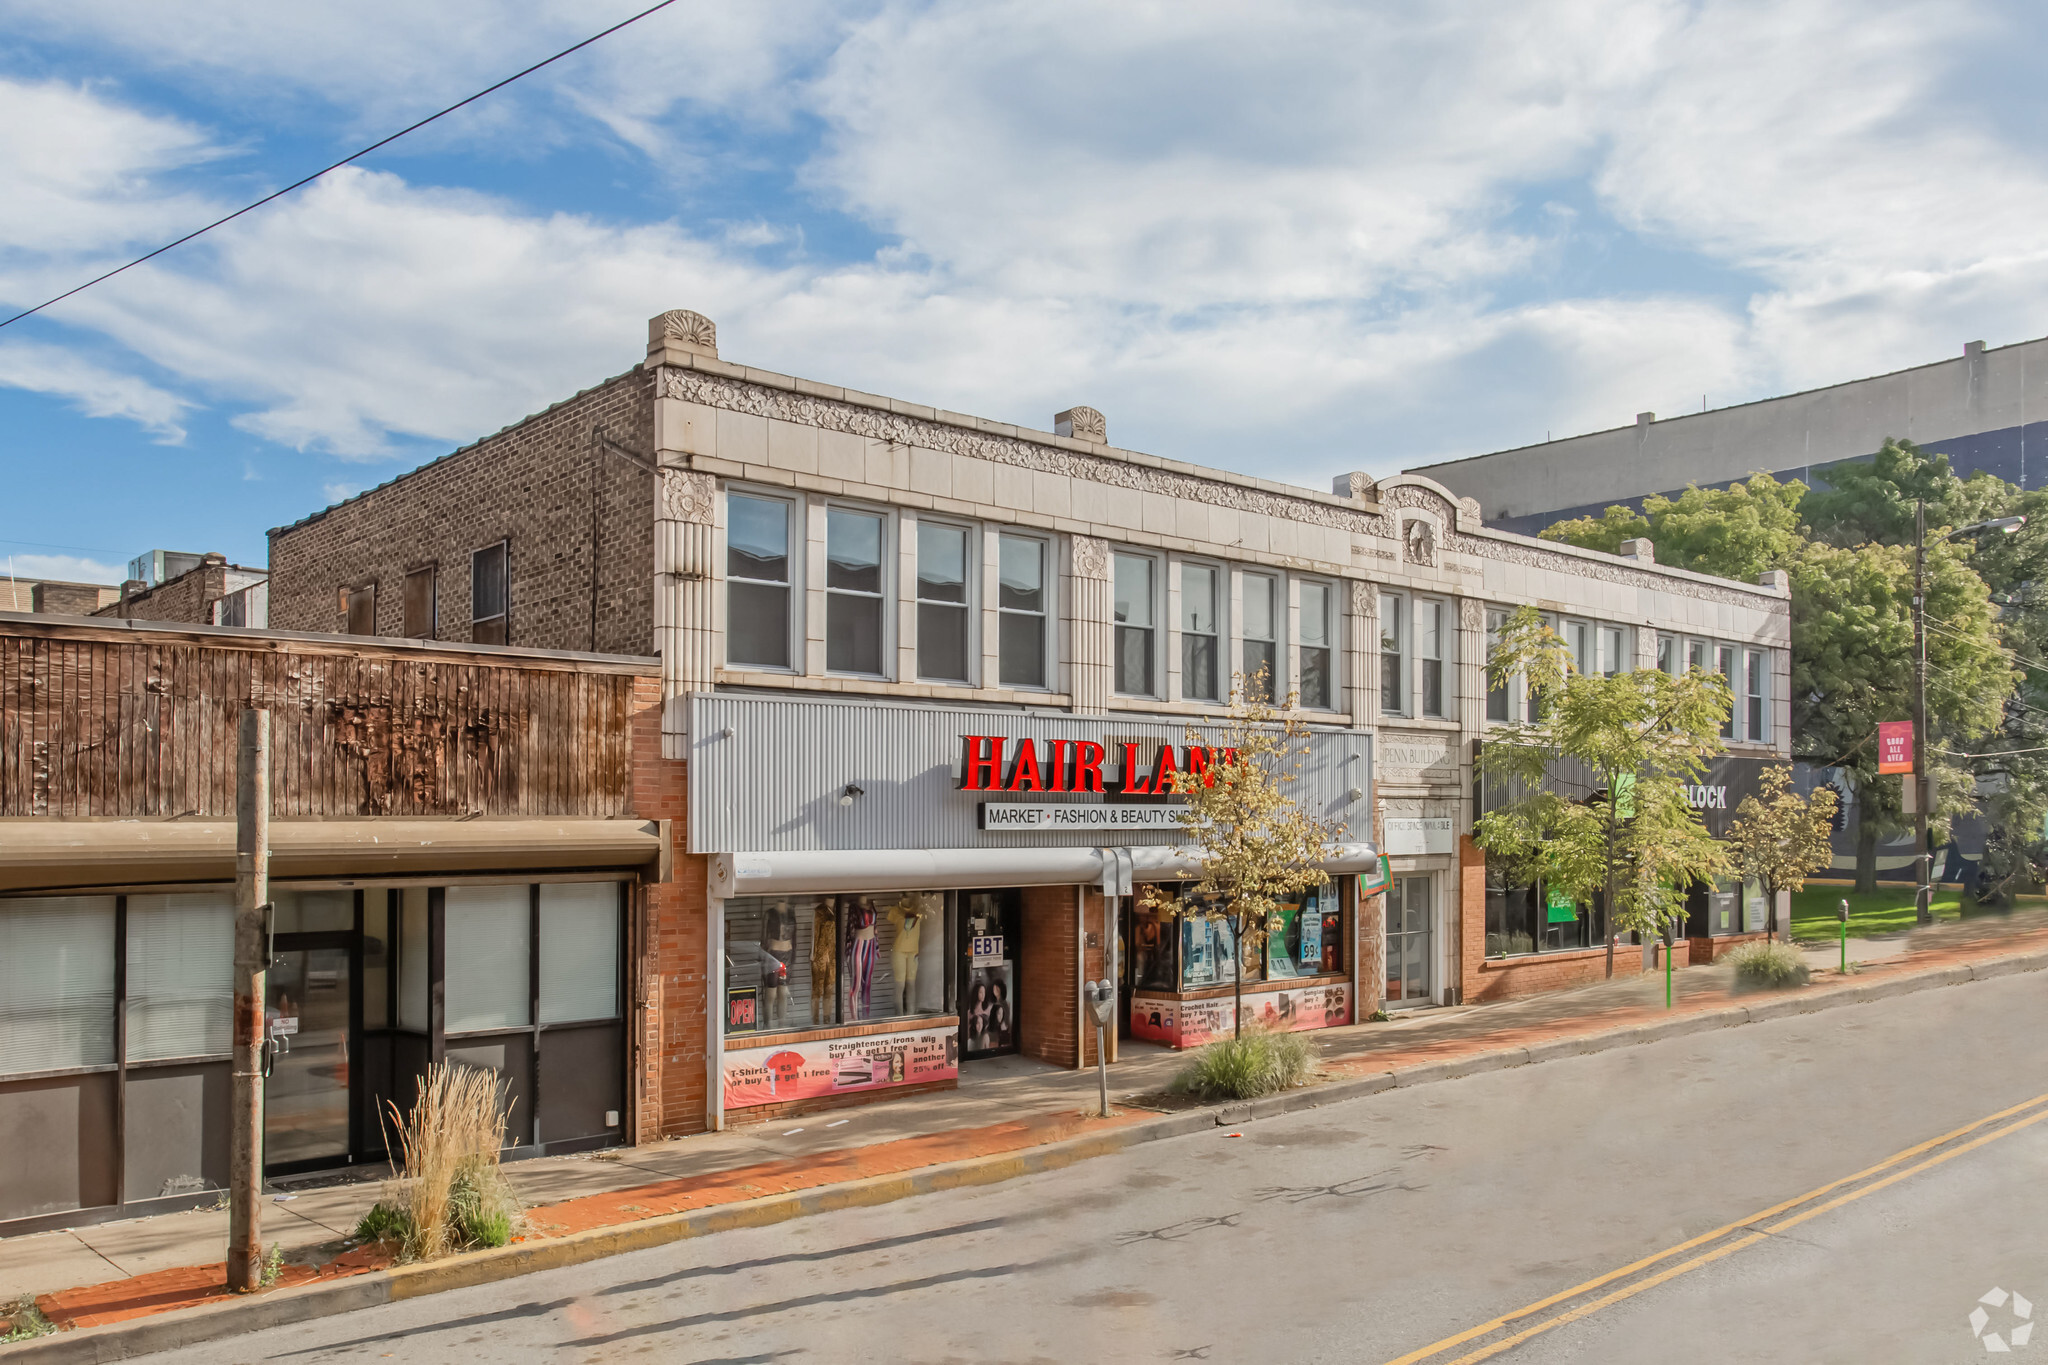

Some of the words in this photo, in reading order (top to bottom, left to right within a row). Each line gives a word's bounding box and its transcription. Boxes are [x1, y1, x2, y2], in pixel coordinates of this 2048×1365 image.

[956, 734, 1107, 793] HAIR
[1384, 748, 1408, 763] PENN
[1409, 748, 1450, 765] BUILDING
[989, 809, 1044, 824] MARKET
[1054, 809, 1107, 824] FASHION
[1110, 809, 1118, 823] &
[1121, 809, 1167, 824] BEAUTY
[1168, 809, 1209, 824] SUPY
[974, 937, 1002, 955] EBT
[731, 998, 755, 1025] OPEN
[1181, 1002, 1205, 1011] Crochet
[1206, 1001, 1219, 1009] Hair
[828, 1036, 915, 1052] Straighteners/Irons
[921, 1035, 936, 1043] Wig
[829, 1052, 846, 1060] buy
[865, 1047, 880, 1057] get
[890, 1044, 908, 1052] free
[913, 1046, 929, 1054] buy
[913, 1054, 945, 1064] another
[731, 1066, 769, 1078] T-Shirts
[932, 1063, 945, 1071] off
[731, 1079, 742, 1087] or
[745, 1077, 762, 1086] buy
[784, 1072, 800, 1082] get
[811, 1069, 831, 1077] free
